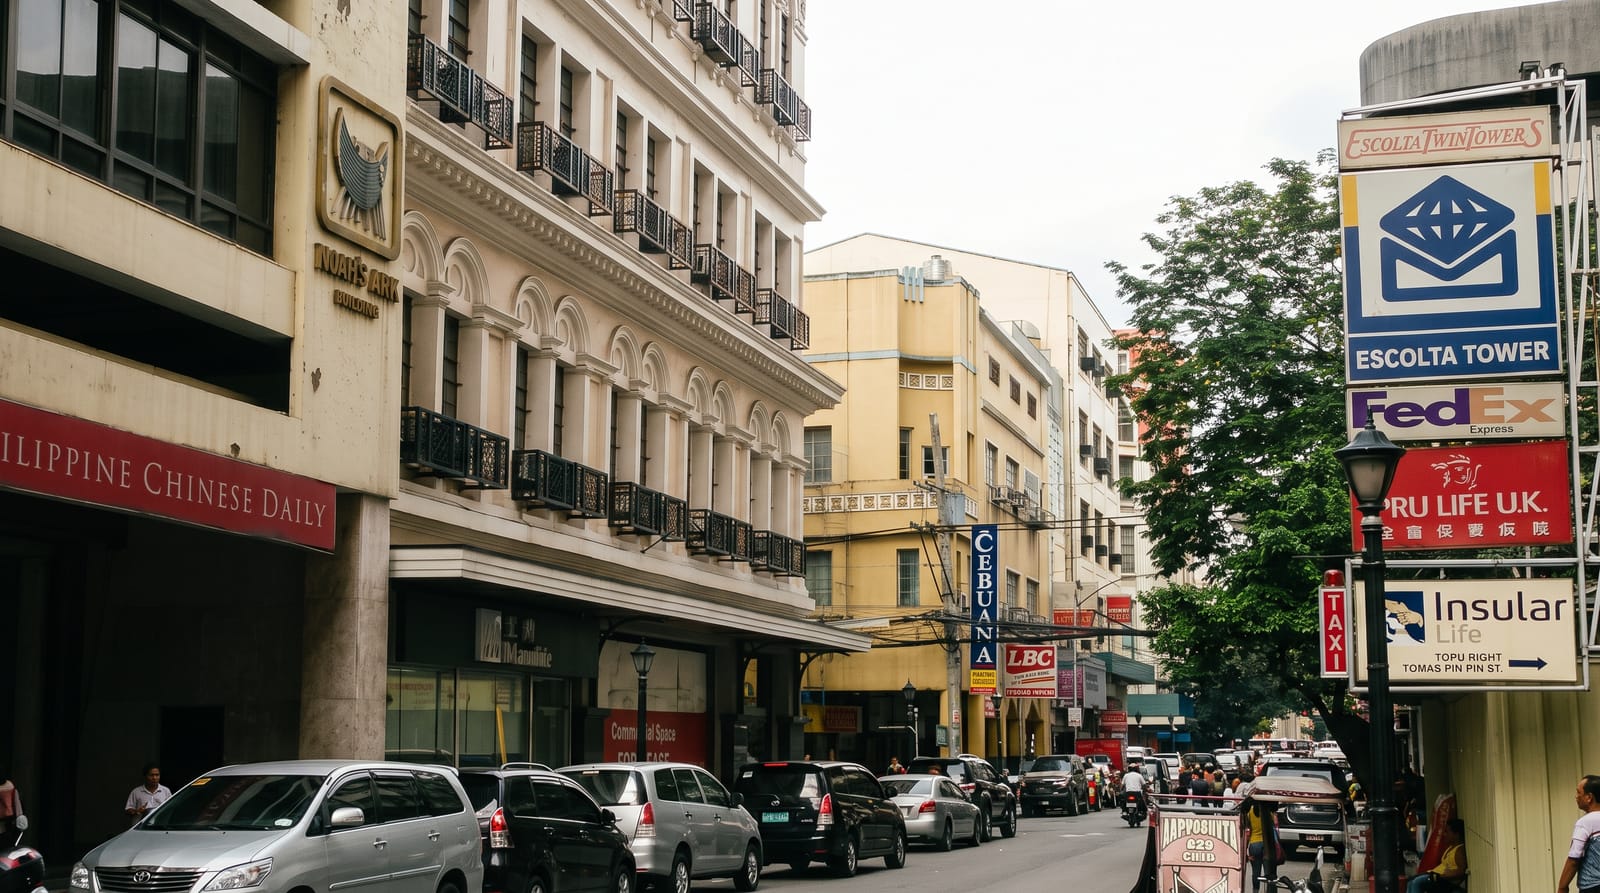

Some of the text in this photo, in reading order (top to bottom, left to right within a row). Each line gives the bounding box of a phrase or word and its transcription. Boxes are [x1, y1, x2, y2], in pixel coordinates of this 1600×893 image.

[314, 243, 400, 304] NOAH'S ARK
[333, 289, 379, 319] BUILDING
[1356, 340, 1550, 370] ESCOLTA TOWER
[1352, 387, 1557, 428] FedEx
[1470, 425, 1514, 436] Express
[143, 462, 252, 514] CHINESE
[262, 488, 327, 528] DAILY
[1437, 493, 1489, 517] LIFE
[1497, 491, 1549, 514] U.K.
[974, 530, 994, 663] CEBUANA
[1435, 591, 1567, 621] Insular
[1327, 594, 1343, 671] TAXI
[1437, 624, 1482, 644] Life
[1007, 649, 1053, 667] LBC
[1403, 664, 1503, 673] TOMAS PIN PIN ST.
[1435, 653, 1502, 662] TOPU RIGHT
[611, 722, 677, 744] Commial Space
[646, 752, 669, 763] EASE
